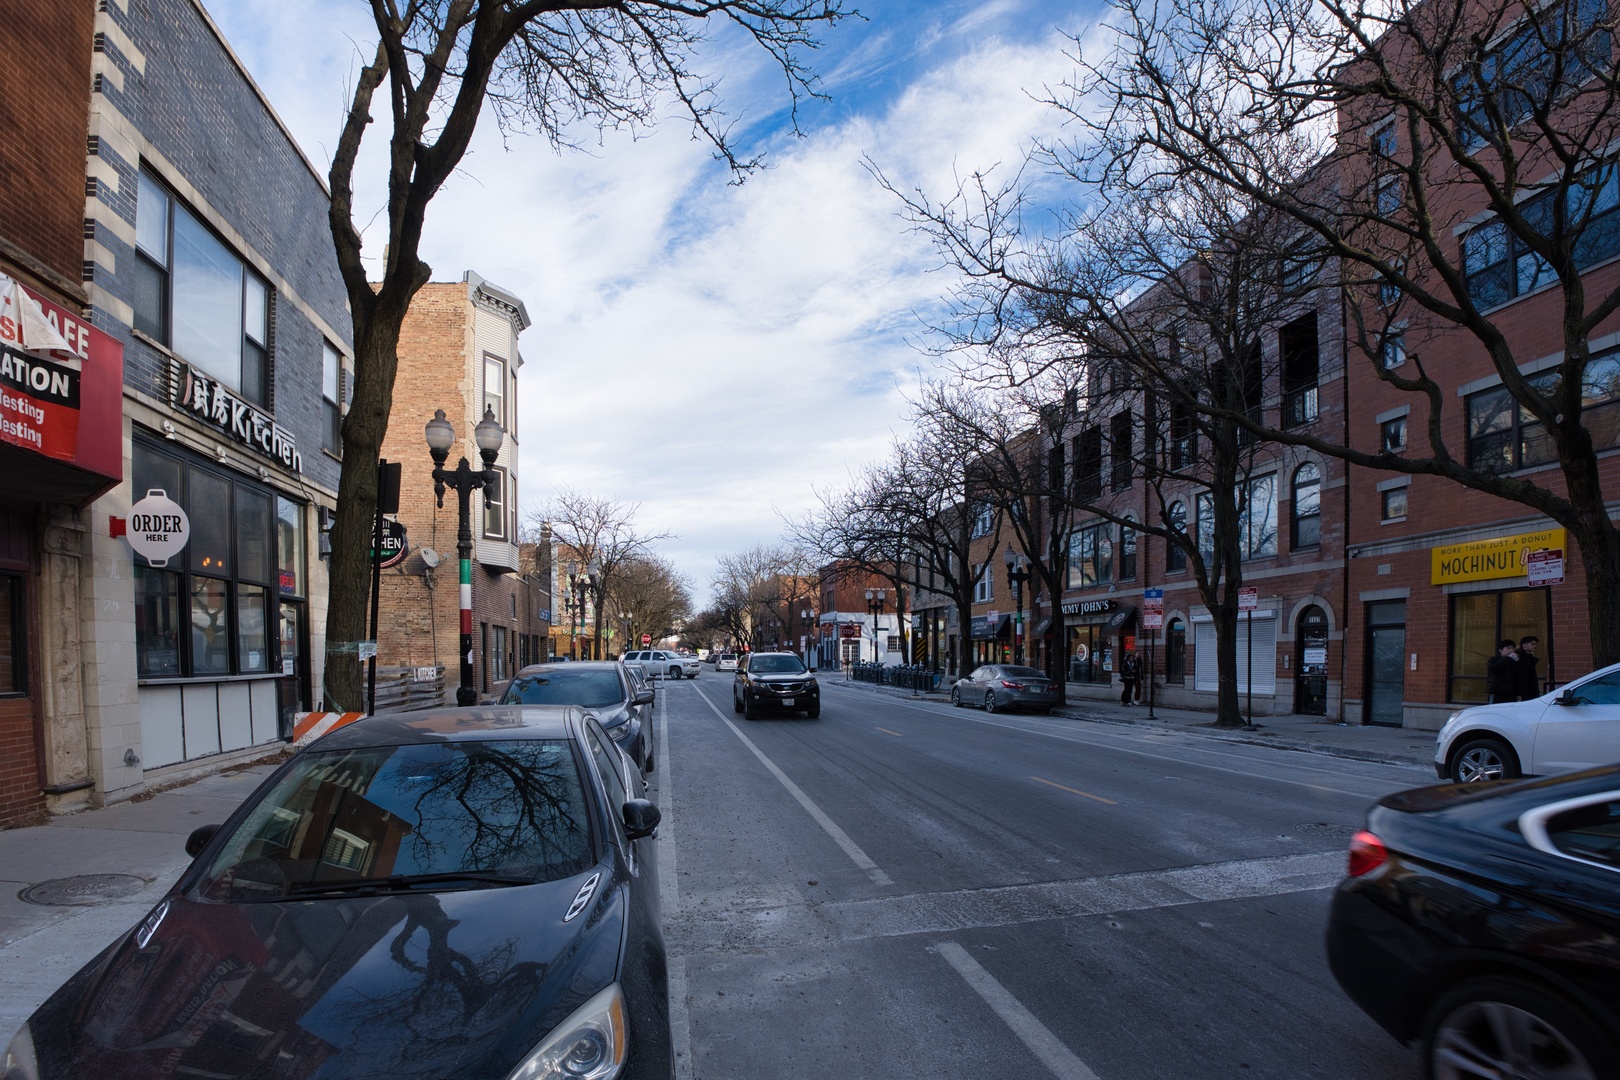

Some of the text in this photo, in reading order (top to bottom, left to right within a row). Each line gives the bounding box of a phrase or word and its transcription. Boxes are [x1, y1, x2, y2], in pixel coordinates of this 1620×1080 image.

[0, 352, 69, 398] ATION
[232, 399, 302, 474] Kitchen
[132, 514, 183, 533] ORDER
[146, 534, 169, 542] HERE
[1441, 547, 1461, 555] MORE
[1465, 543, 1486, 552] THAN
[1489, 539, 1508, 549] JUST
[1522, 533, 1552, 544] DONUT
[1441, 550, 1516, 577] MOCHINUT
[1080, 600, 1109, 615] JOHN'S
